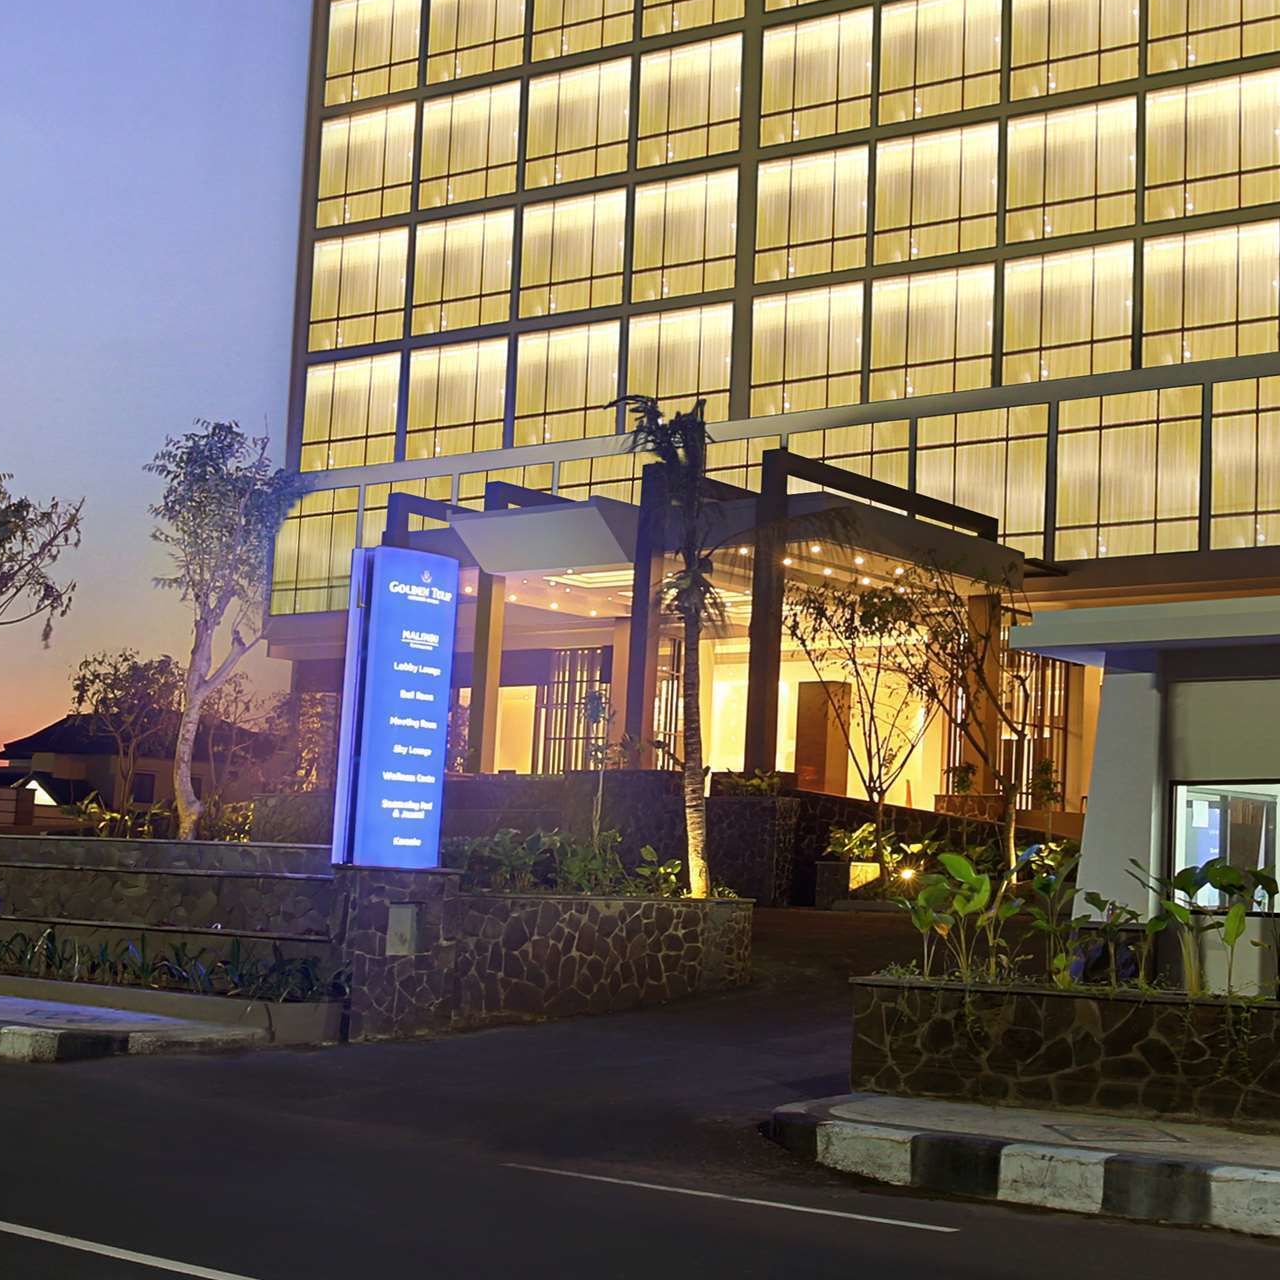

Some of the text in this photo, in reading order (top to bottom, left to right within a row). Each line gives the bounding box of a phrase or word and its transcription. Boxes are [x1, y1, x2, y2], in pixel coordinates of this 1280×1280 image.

[389, 581, 430, 597] GOLDEN
[431, 588, 453, 602] TULIP
[393, 662, 418, 674] Lobby
